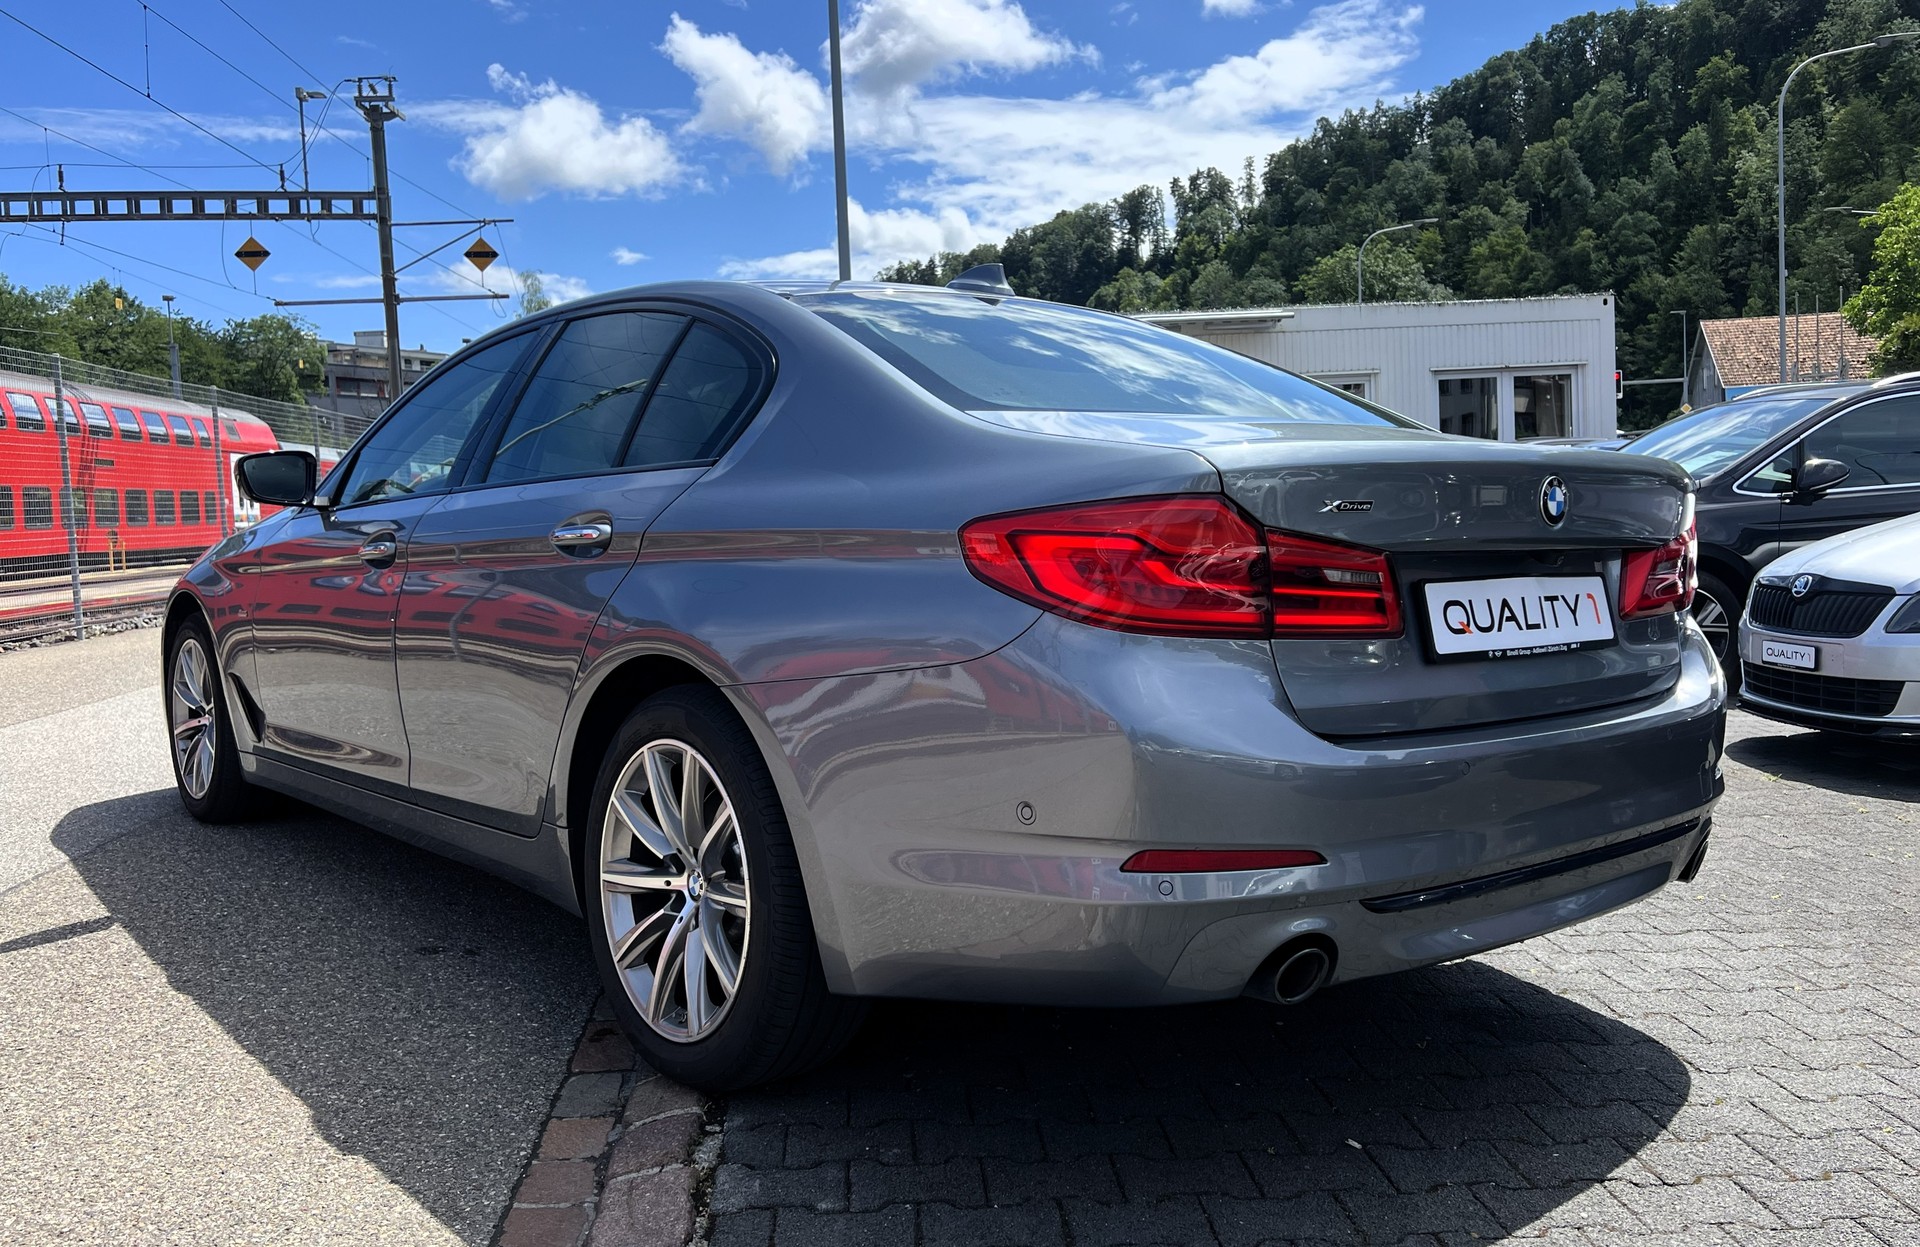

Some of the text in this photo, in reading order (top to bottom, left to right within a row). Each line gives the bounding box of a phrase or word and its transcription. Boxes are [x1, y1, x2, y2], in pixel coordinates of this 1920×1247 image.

[1443, 593, 1601, 634] QUALITY 1
[1766, 647, 1805, 661] QUALITY
